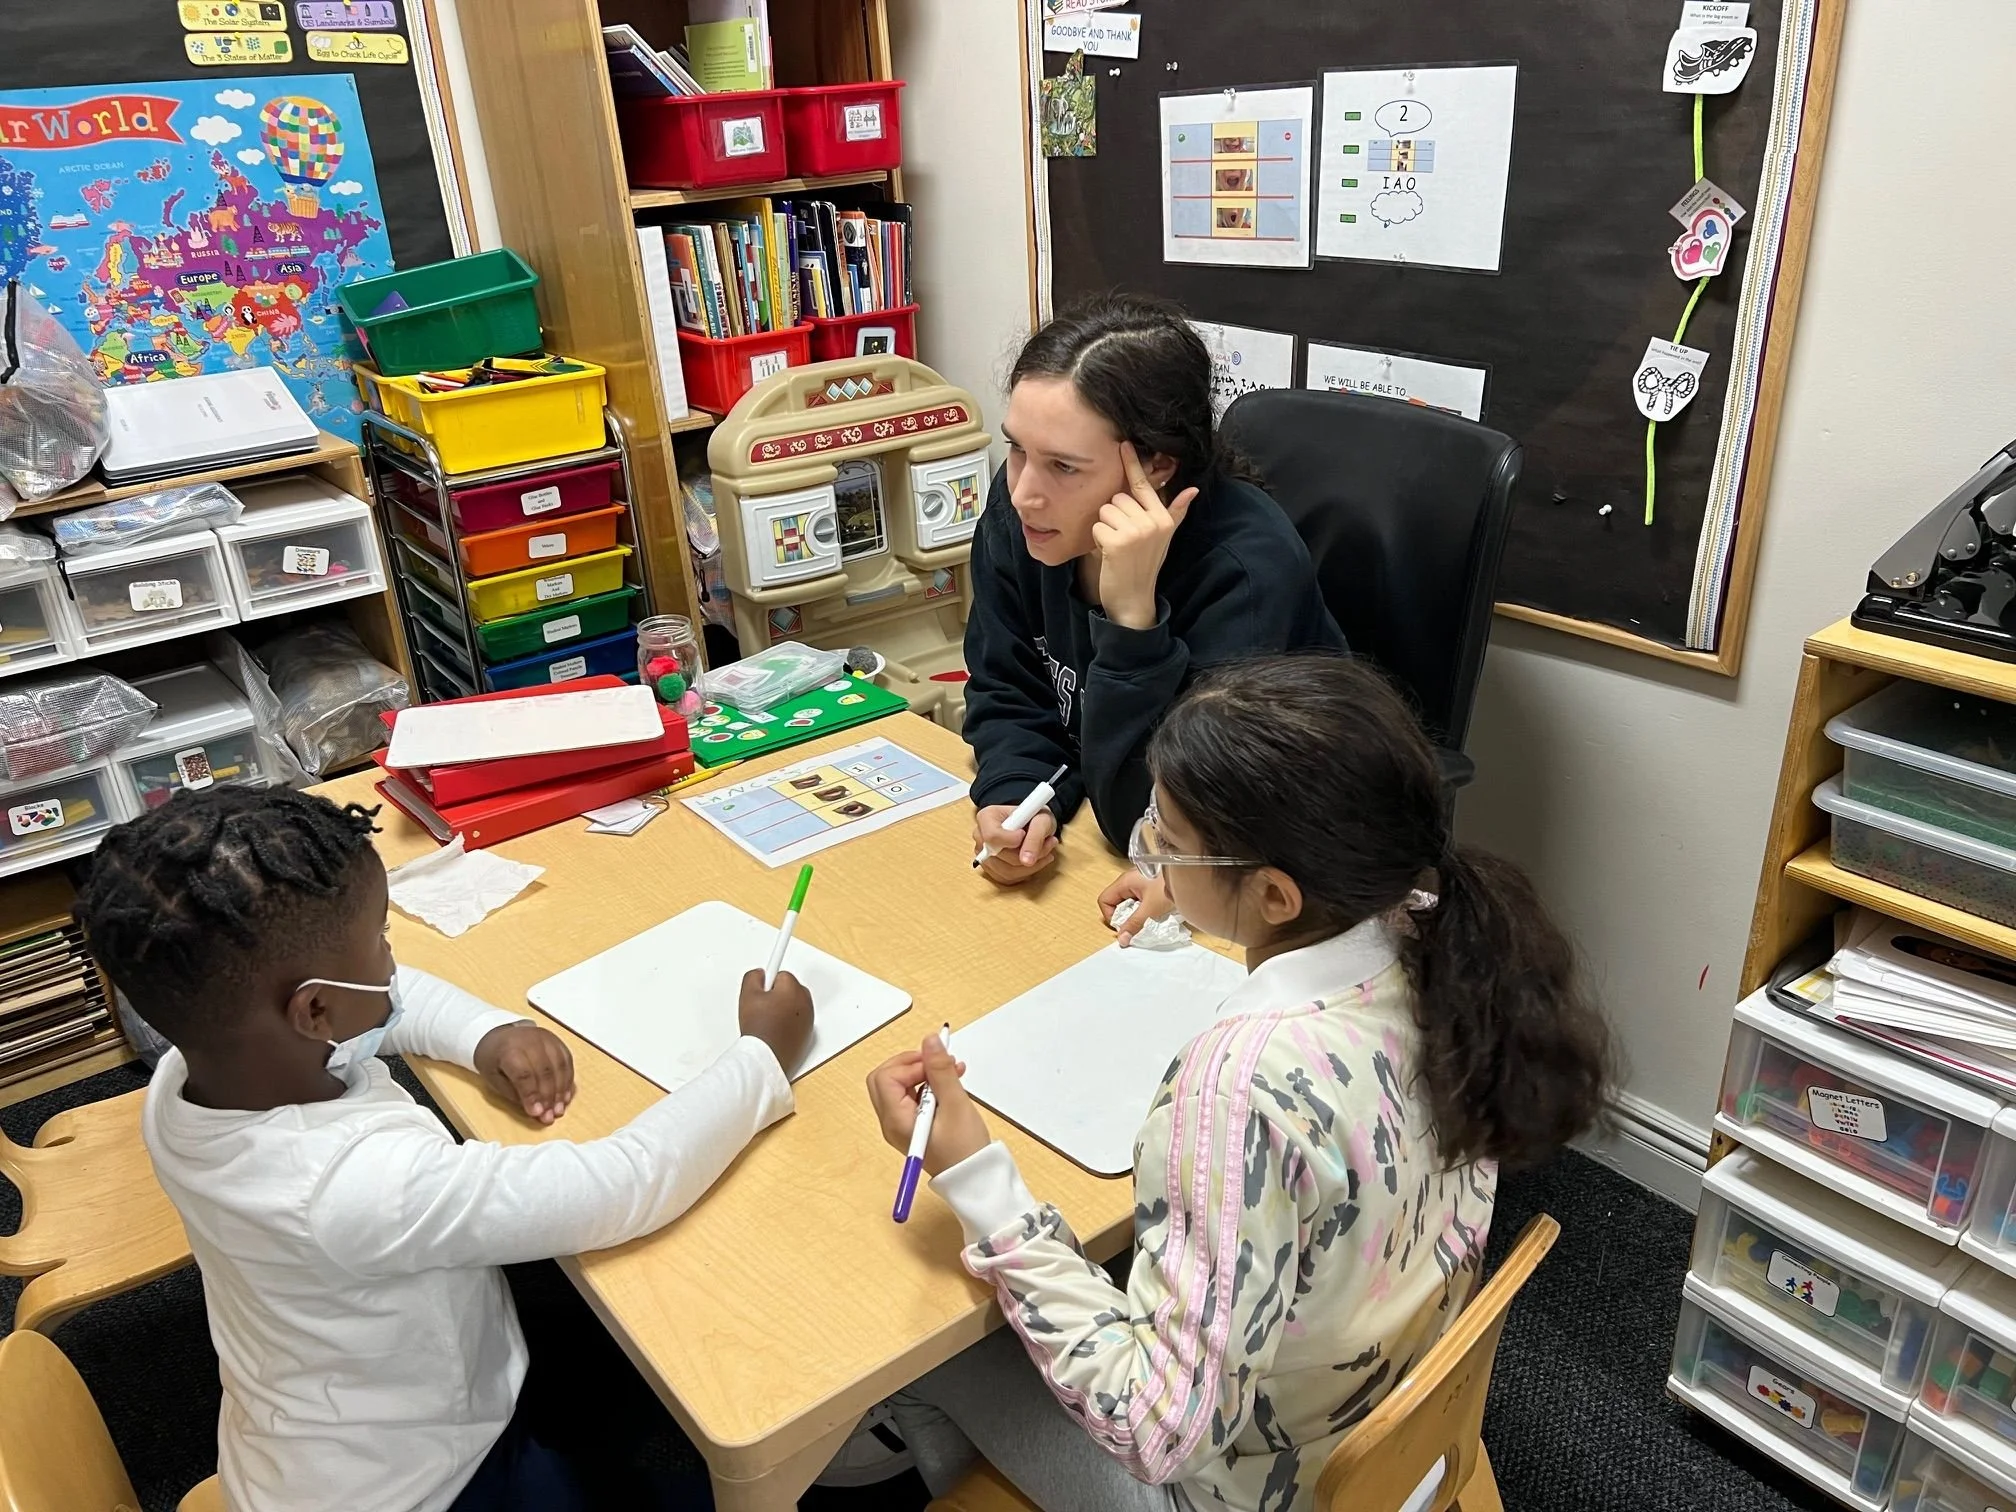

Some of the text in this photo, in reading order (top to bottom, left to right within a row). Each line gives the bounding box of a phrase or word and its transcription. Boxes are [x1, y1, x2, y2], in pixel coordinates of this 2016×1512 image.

[241, 18, 270, 27] System
[364, 18, 395, 26] Symbols
[1052, 26, 1131, 41] GOODBYE AND THANK
[1083, 41, 1099, 51] YOU
[317, 49, 330, 58] Egg
[1400, 105, 1408, 121] 2
[31, 100, 158, 141] World
[59, 162, 124, 174] ARCTIC OCEAN
[1394, 177, 1401, 189] A
[1406, 177, 1416, 190] O
[1681, 189, 1699, 207] FEELINGS
[191, 250, 220, 258] RUSSIA
[280, 262, 302, 273] Asia
[180, 272, 218, 284] Europe
[131, 354, 166, 364] Africa
[1324, 375, 1406, 396] WE WILL BE ABLE TO
[1812, 1089, 1879, 1109] Magnet Letters
[1782, 1256, 1831, 1285] Connecting People
[1773, 1378, 1794, 1394] Gears
